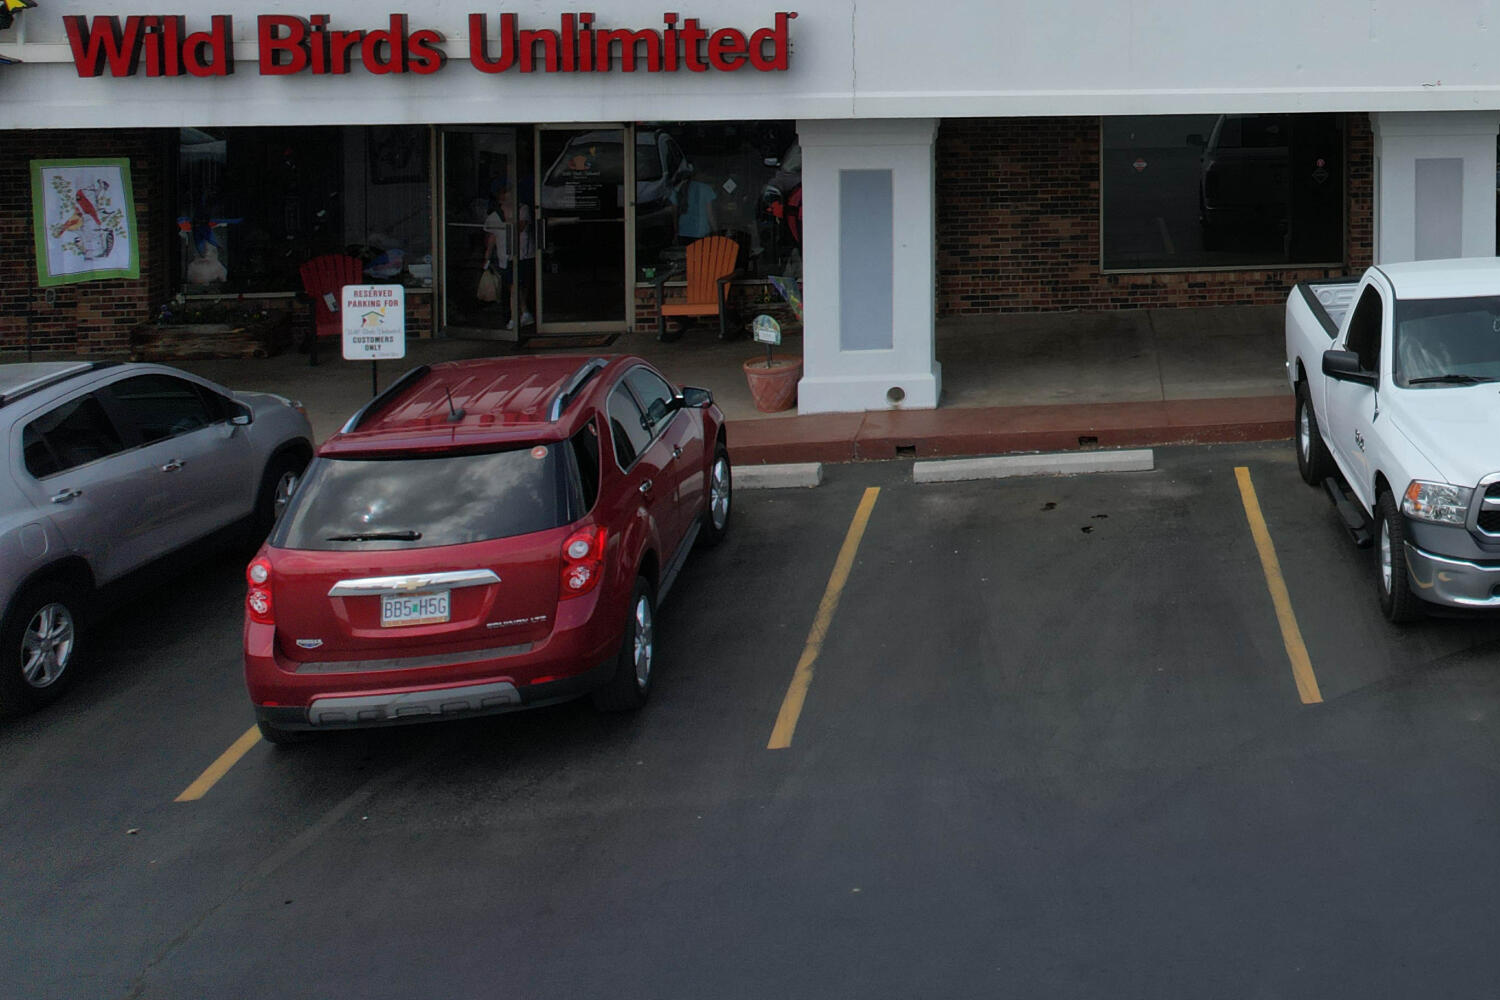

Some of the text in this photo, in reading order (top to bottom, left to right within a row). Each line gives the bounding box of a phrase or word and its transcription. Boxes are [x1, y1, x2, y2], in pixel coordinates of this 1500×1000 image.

[62, 11, 790, 78] Wild Birds Unlimited
[353, 336, 394, 344] CUSTOMERS
